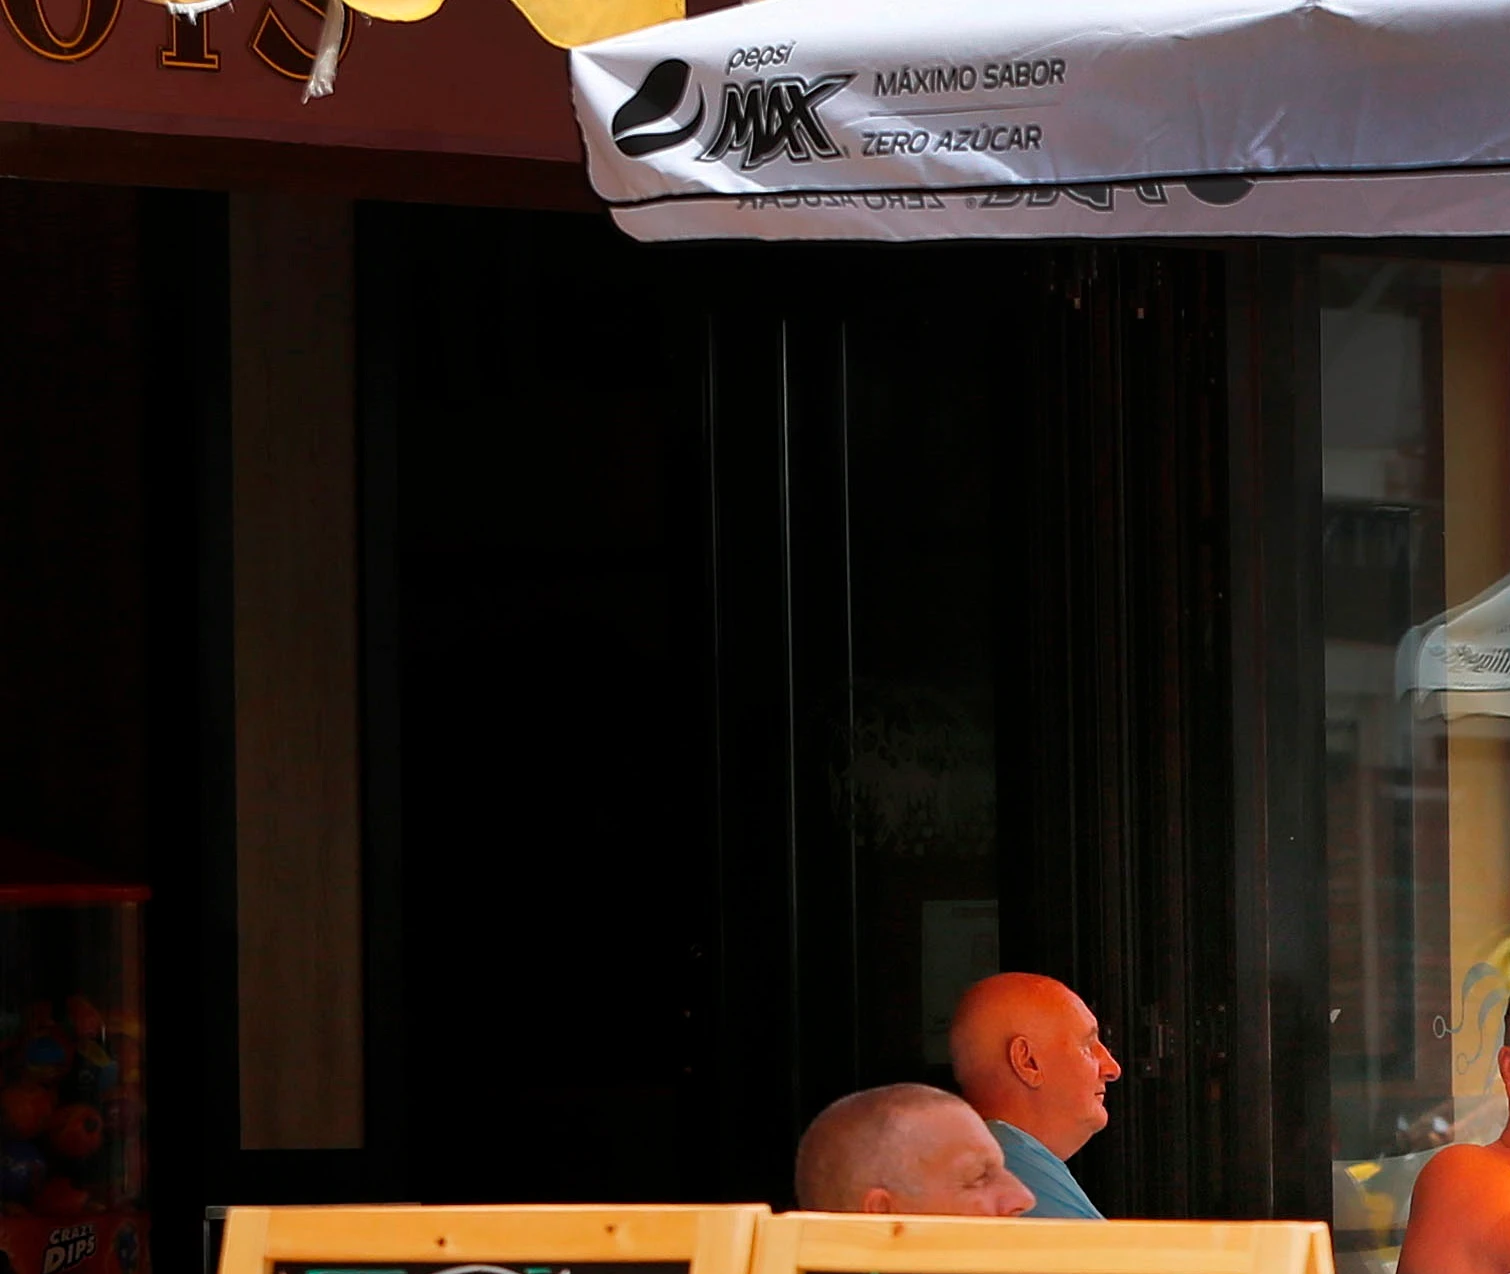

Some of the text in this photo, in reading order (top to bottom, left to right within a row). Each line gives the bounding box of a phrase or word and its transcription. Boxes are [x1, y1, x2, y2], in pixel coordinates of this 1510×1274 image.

[727, 39, 799, 75] pepsi
[874, 58, 1067, 98] MÁXIMO SABOR
[696, 73, 856, 172] MAX
[861, 122, 1043, 157] ZERO AZÚCAR
